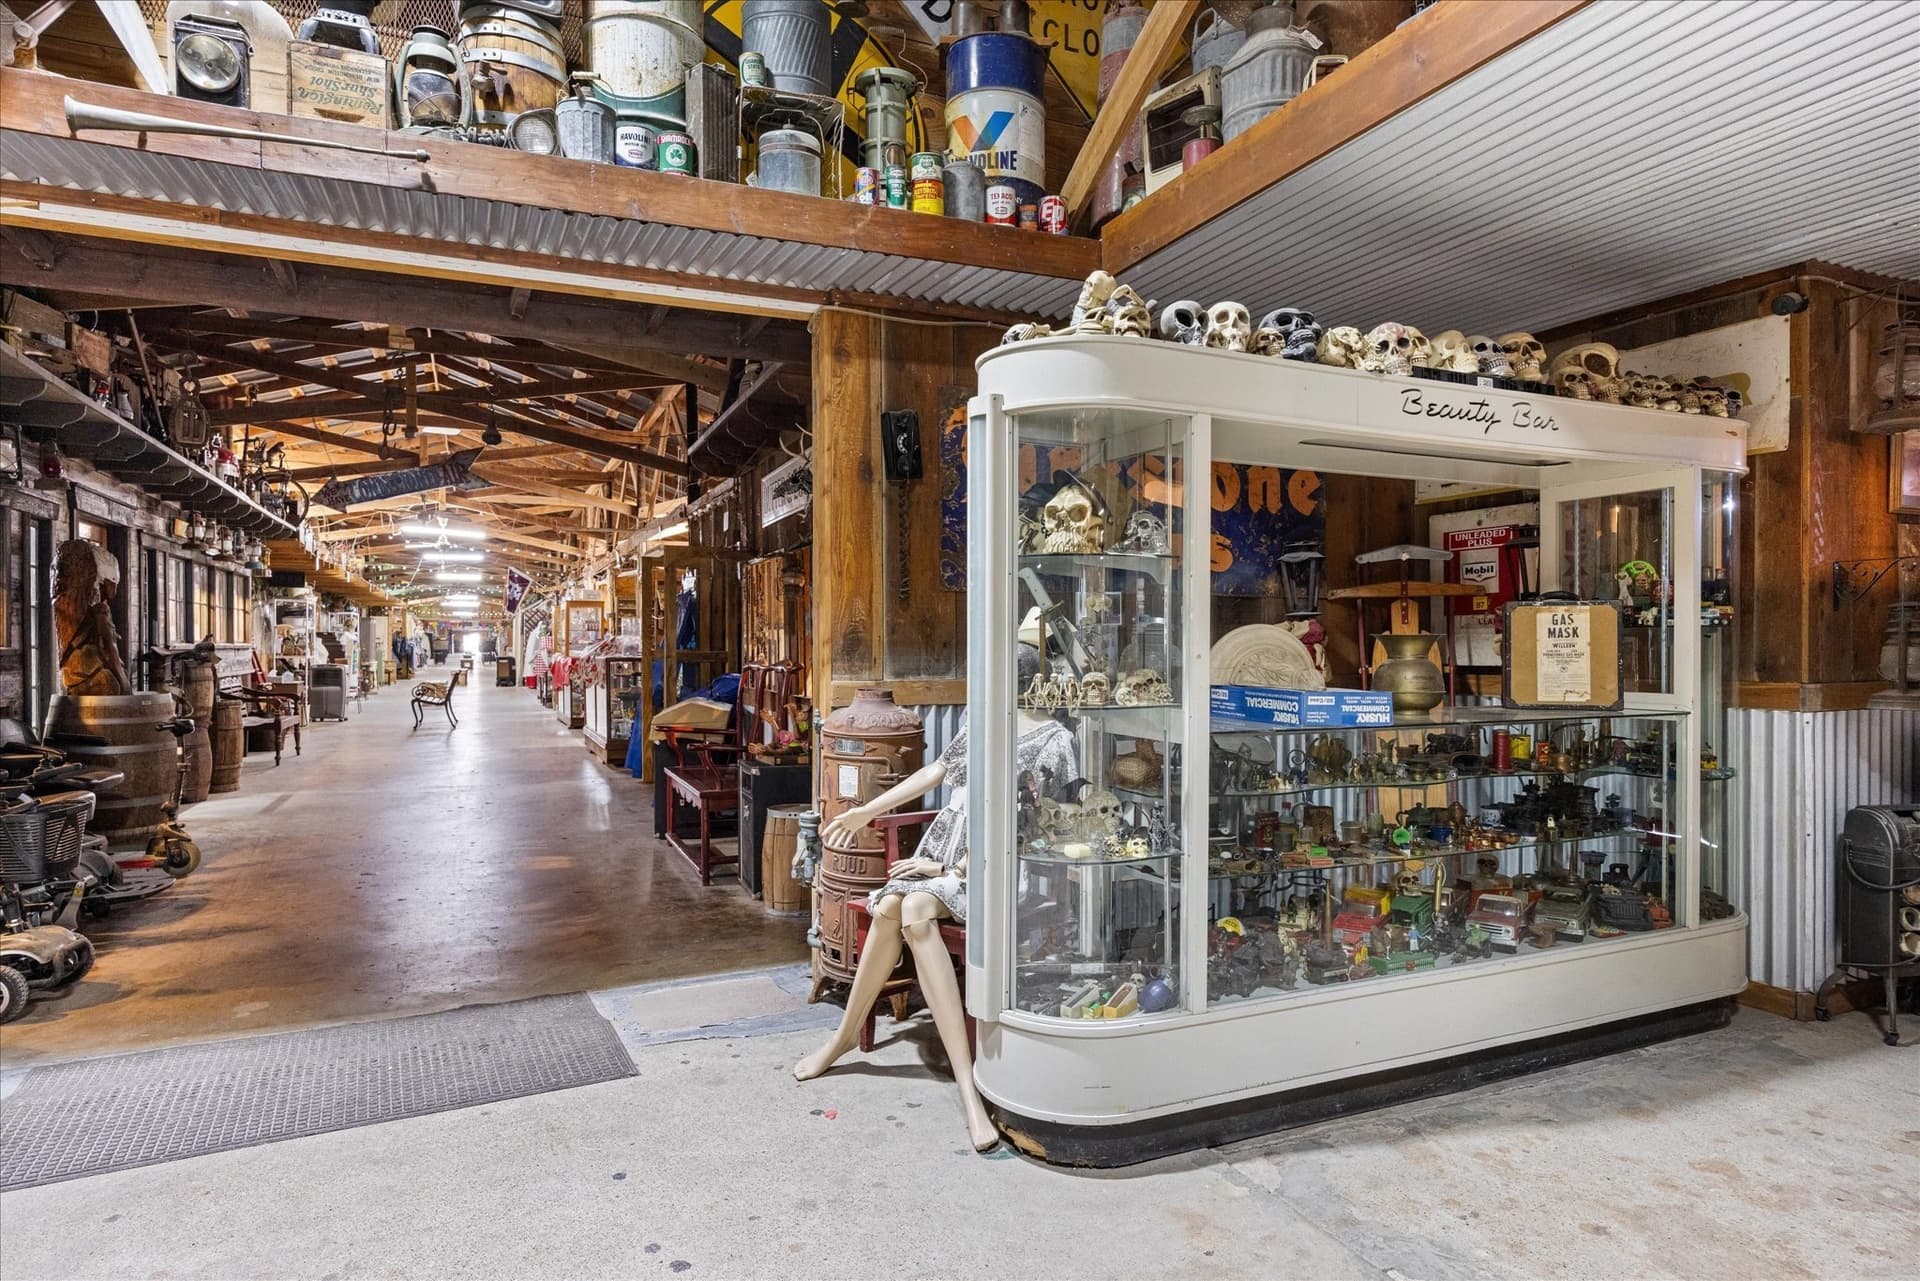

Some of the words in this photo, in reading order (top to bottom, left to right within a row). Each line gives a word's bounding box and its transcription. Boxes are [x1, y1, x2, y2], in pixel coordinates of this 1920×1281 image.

[310, 76, 341, 92] Shot
[341, 83, 377, 98] Shur
[298, 86, 384, 115] Remington
[620, 132, 651, 145] HAVOLINE
[1401, 388, 1502, 434] Beauty
[1512, 401, 1559, 431] Bar
[442, 461, 469, 484] AIR
[1455, 528, 1506, 541] UNLEADED
[1467, 537, 1493, 547] PLUS
[1465, 565, 1494, 575] Mobil
[1552, 613, 1574, 626] GAS
[1547, 626, 1580, 639] MASK
[1245, 697, 1299, 712] COMMERCIAL
[1341, 705, 1390, 713] COMMERCIAL
[1273, 711, 1300, 725] HUSKY
[1356, 713, 1390, 724] HUSKY
[832, 855, 867, 875] RUUD
